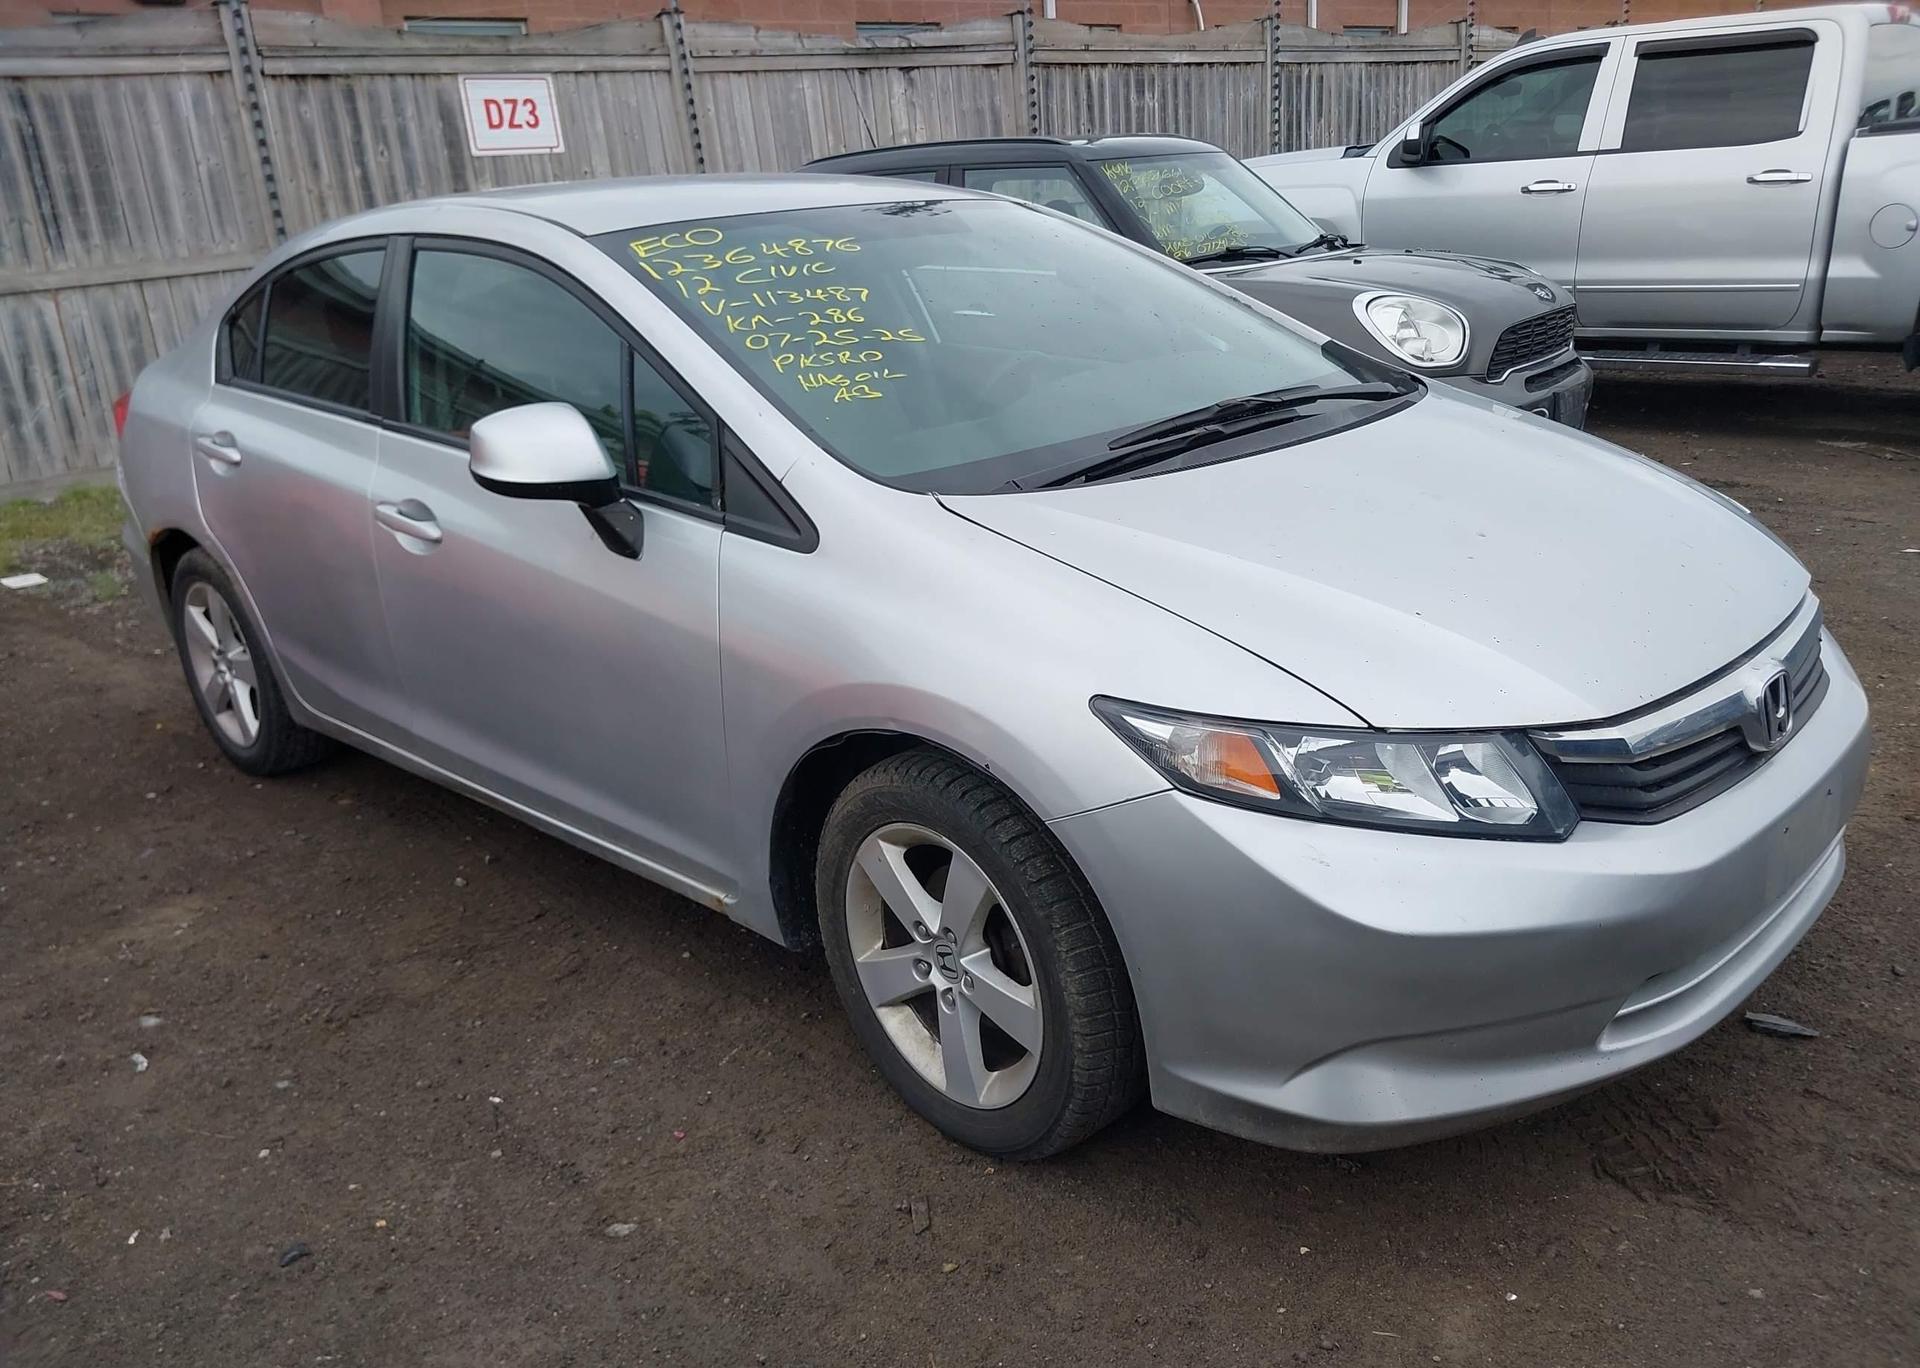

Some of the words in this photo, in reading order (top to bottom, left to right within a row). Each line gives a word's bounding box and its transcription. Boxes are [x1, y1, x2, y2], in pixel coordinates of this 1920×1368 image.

[483, 97, 541, 130] DZ3
[629, 228, 723, 258] ECO
[675, 276, 725, 299] 12
[735, 261, 836, 284] CIVIC
[701, 286, 870, 316] V-113487
[726, 306, 866, 334] KM-286
[745, 328, 926, 350] 07-25-25
[854, 368, 908, 382] OIL
